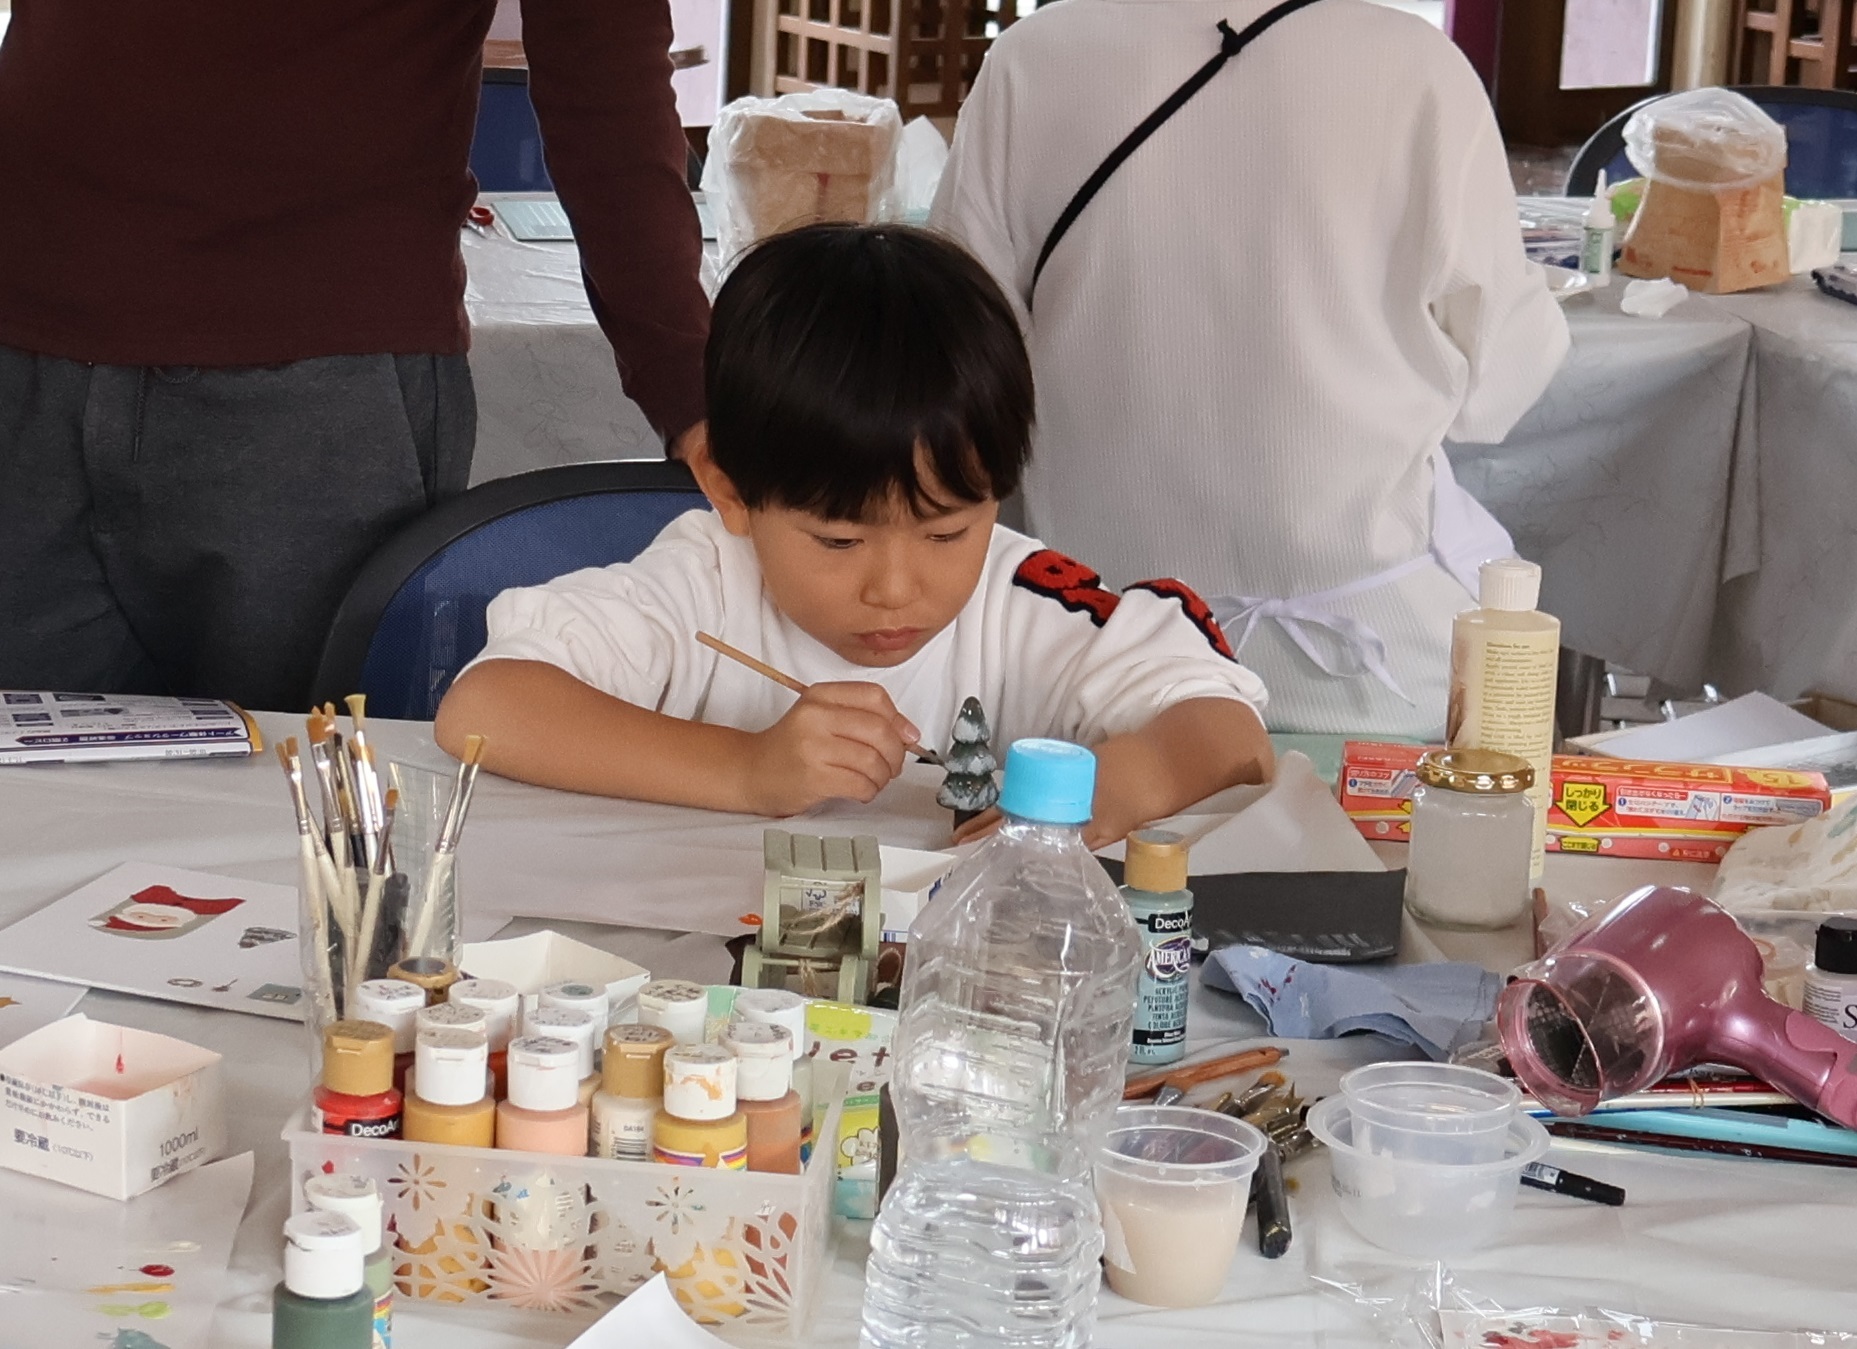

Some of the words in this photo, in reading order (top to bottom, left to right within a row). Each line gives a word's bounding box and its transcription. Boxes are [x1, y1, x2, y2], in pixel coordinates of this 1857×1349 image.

[1557, 758, 1722, 780] サランラッ
[1566, 787, 1602, 799] しっかり
[1565, 799, 1599, 812] 閉じる
[14, 1127, 51, 1152] 要冷蔵
[159, 1125, 199, 1157] 1000ml
[151, 1157, 179, 1182] 要冷蔵
